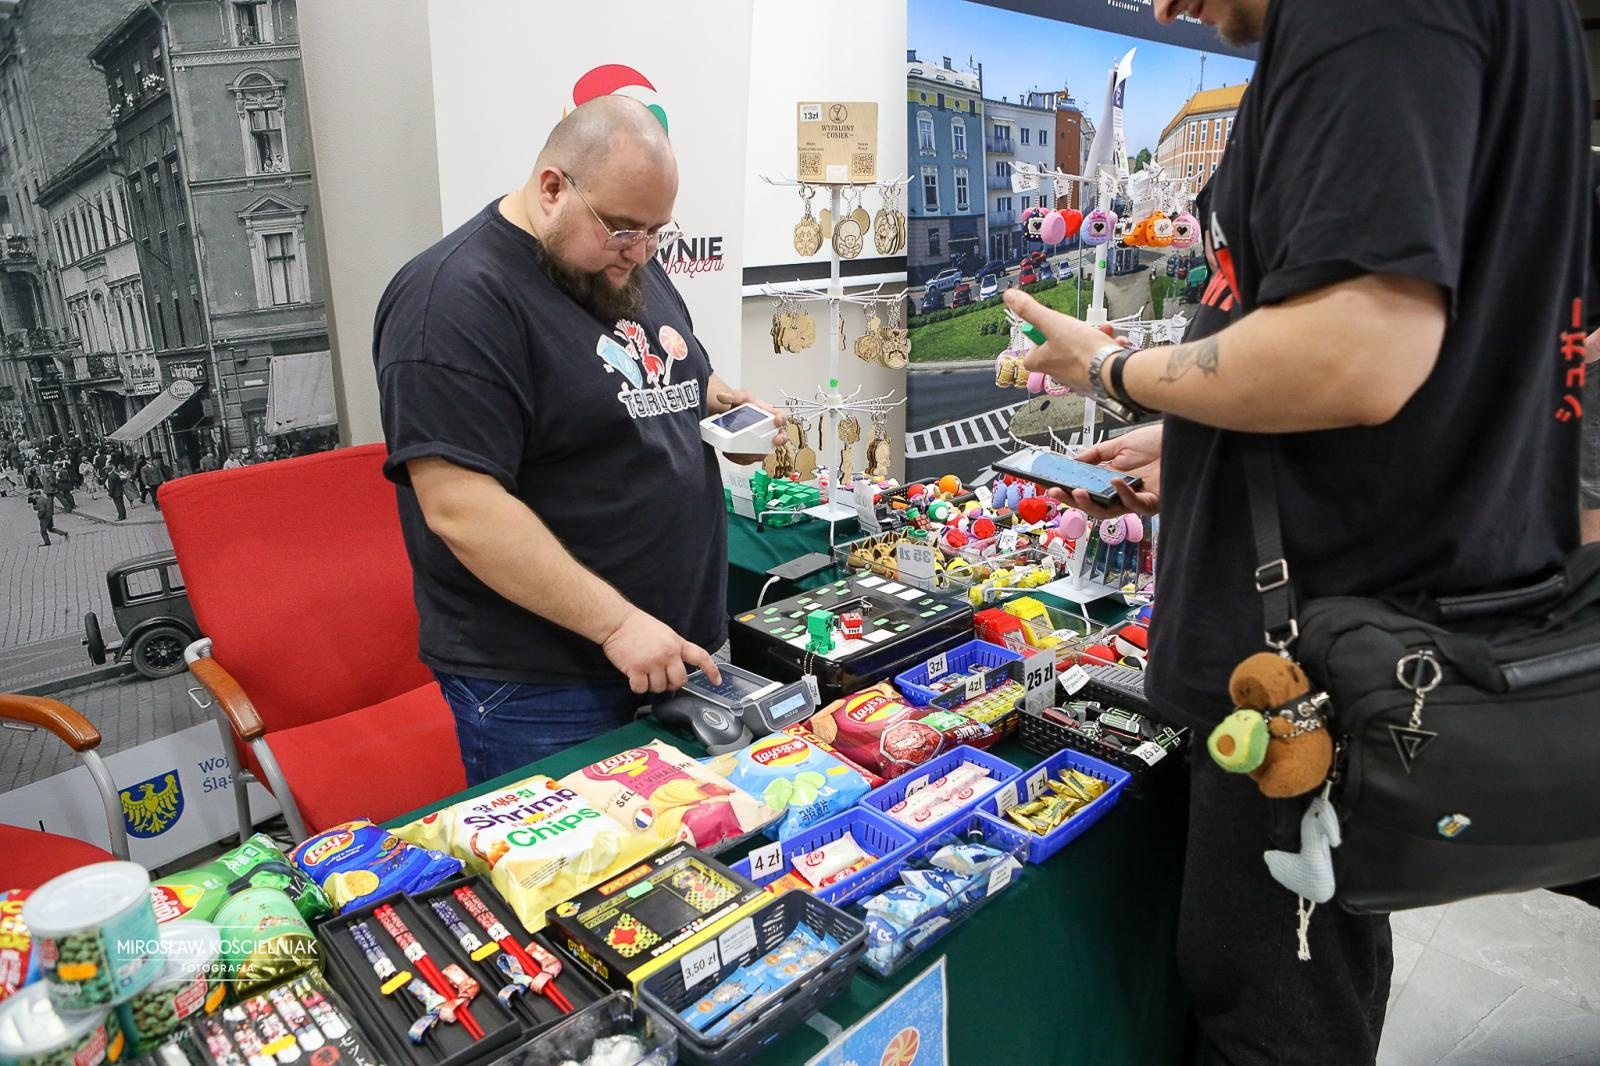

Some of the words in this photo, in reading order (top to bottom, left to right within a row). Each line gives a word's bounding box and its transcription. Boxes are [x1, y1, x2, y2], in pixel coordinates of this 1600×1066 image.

[929, 659, 944, 675] 3zł
[1027, 668, 1042, 691] 25
[1044, 662, 1054, 683] zł
[968, 679, 982, 692] 4zł
[1140, 750, 1151, 760] 25
[1152, 745, 1160, 755] zł
[1029, 783, 1035, 795] 1
[1037, 774, 1047, 790] zł
[464, 788, 578, 830] Shrimp
[616, 788, 636, 808] SEL
[507, 808, 602, 847] Chips
[754, 855, 763, 871] 4
[768, 848, 780, 867] zł
[684, 959, 706, 979] 3,50
[708, 956, 717, 967] zł
